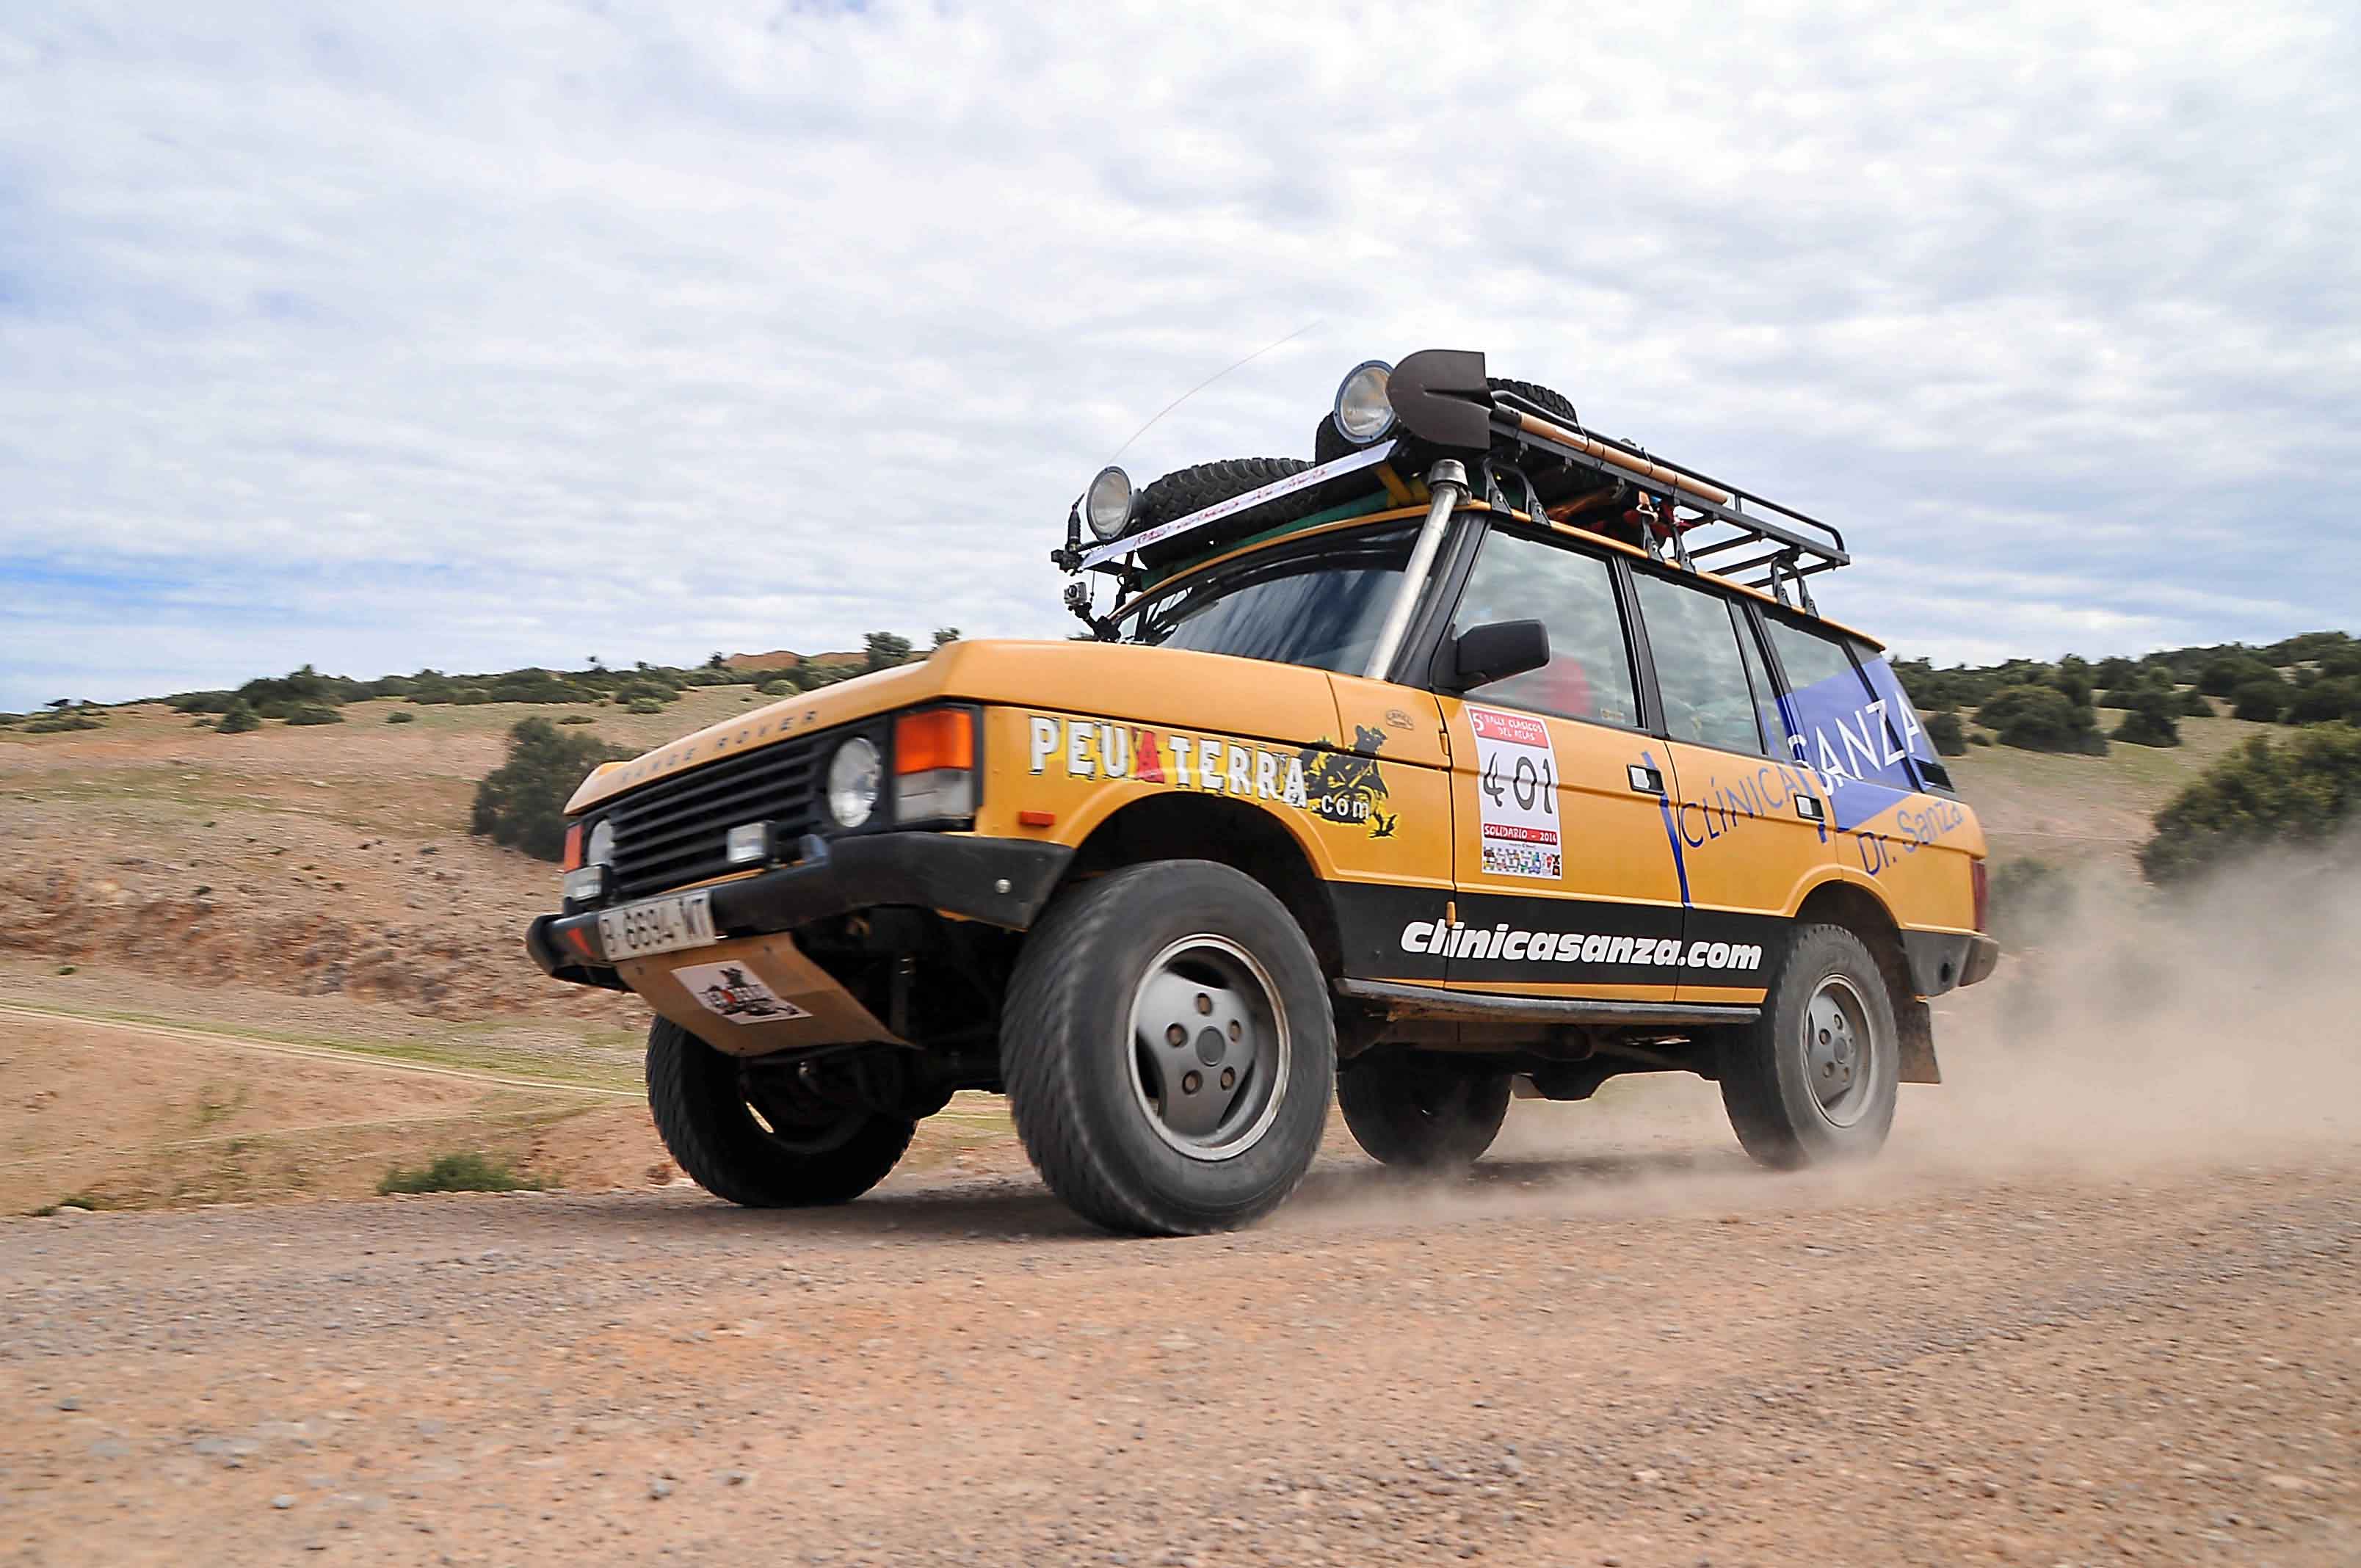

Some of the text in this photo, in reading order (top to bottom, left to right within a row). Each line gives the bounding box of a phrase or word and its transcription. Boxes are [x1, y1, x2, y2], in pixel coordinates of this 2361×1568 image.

[1787, 692, 1921, 796] SANZA
[1482, 751, 1553, 815] 401
[1484, 824, 1528, 840] SOLIDARIO
[1857, 799, 1964, 876] Dr. Sanza
[1400, 918, 1763, 970] clinicasanza.com
